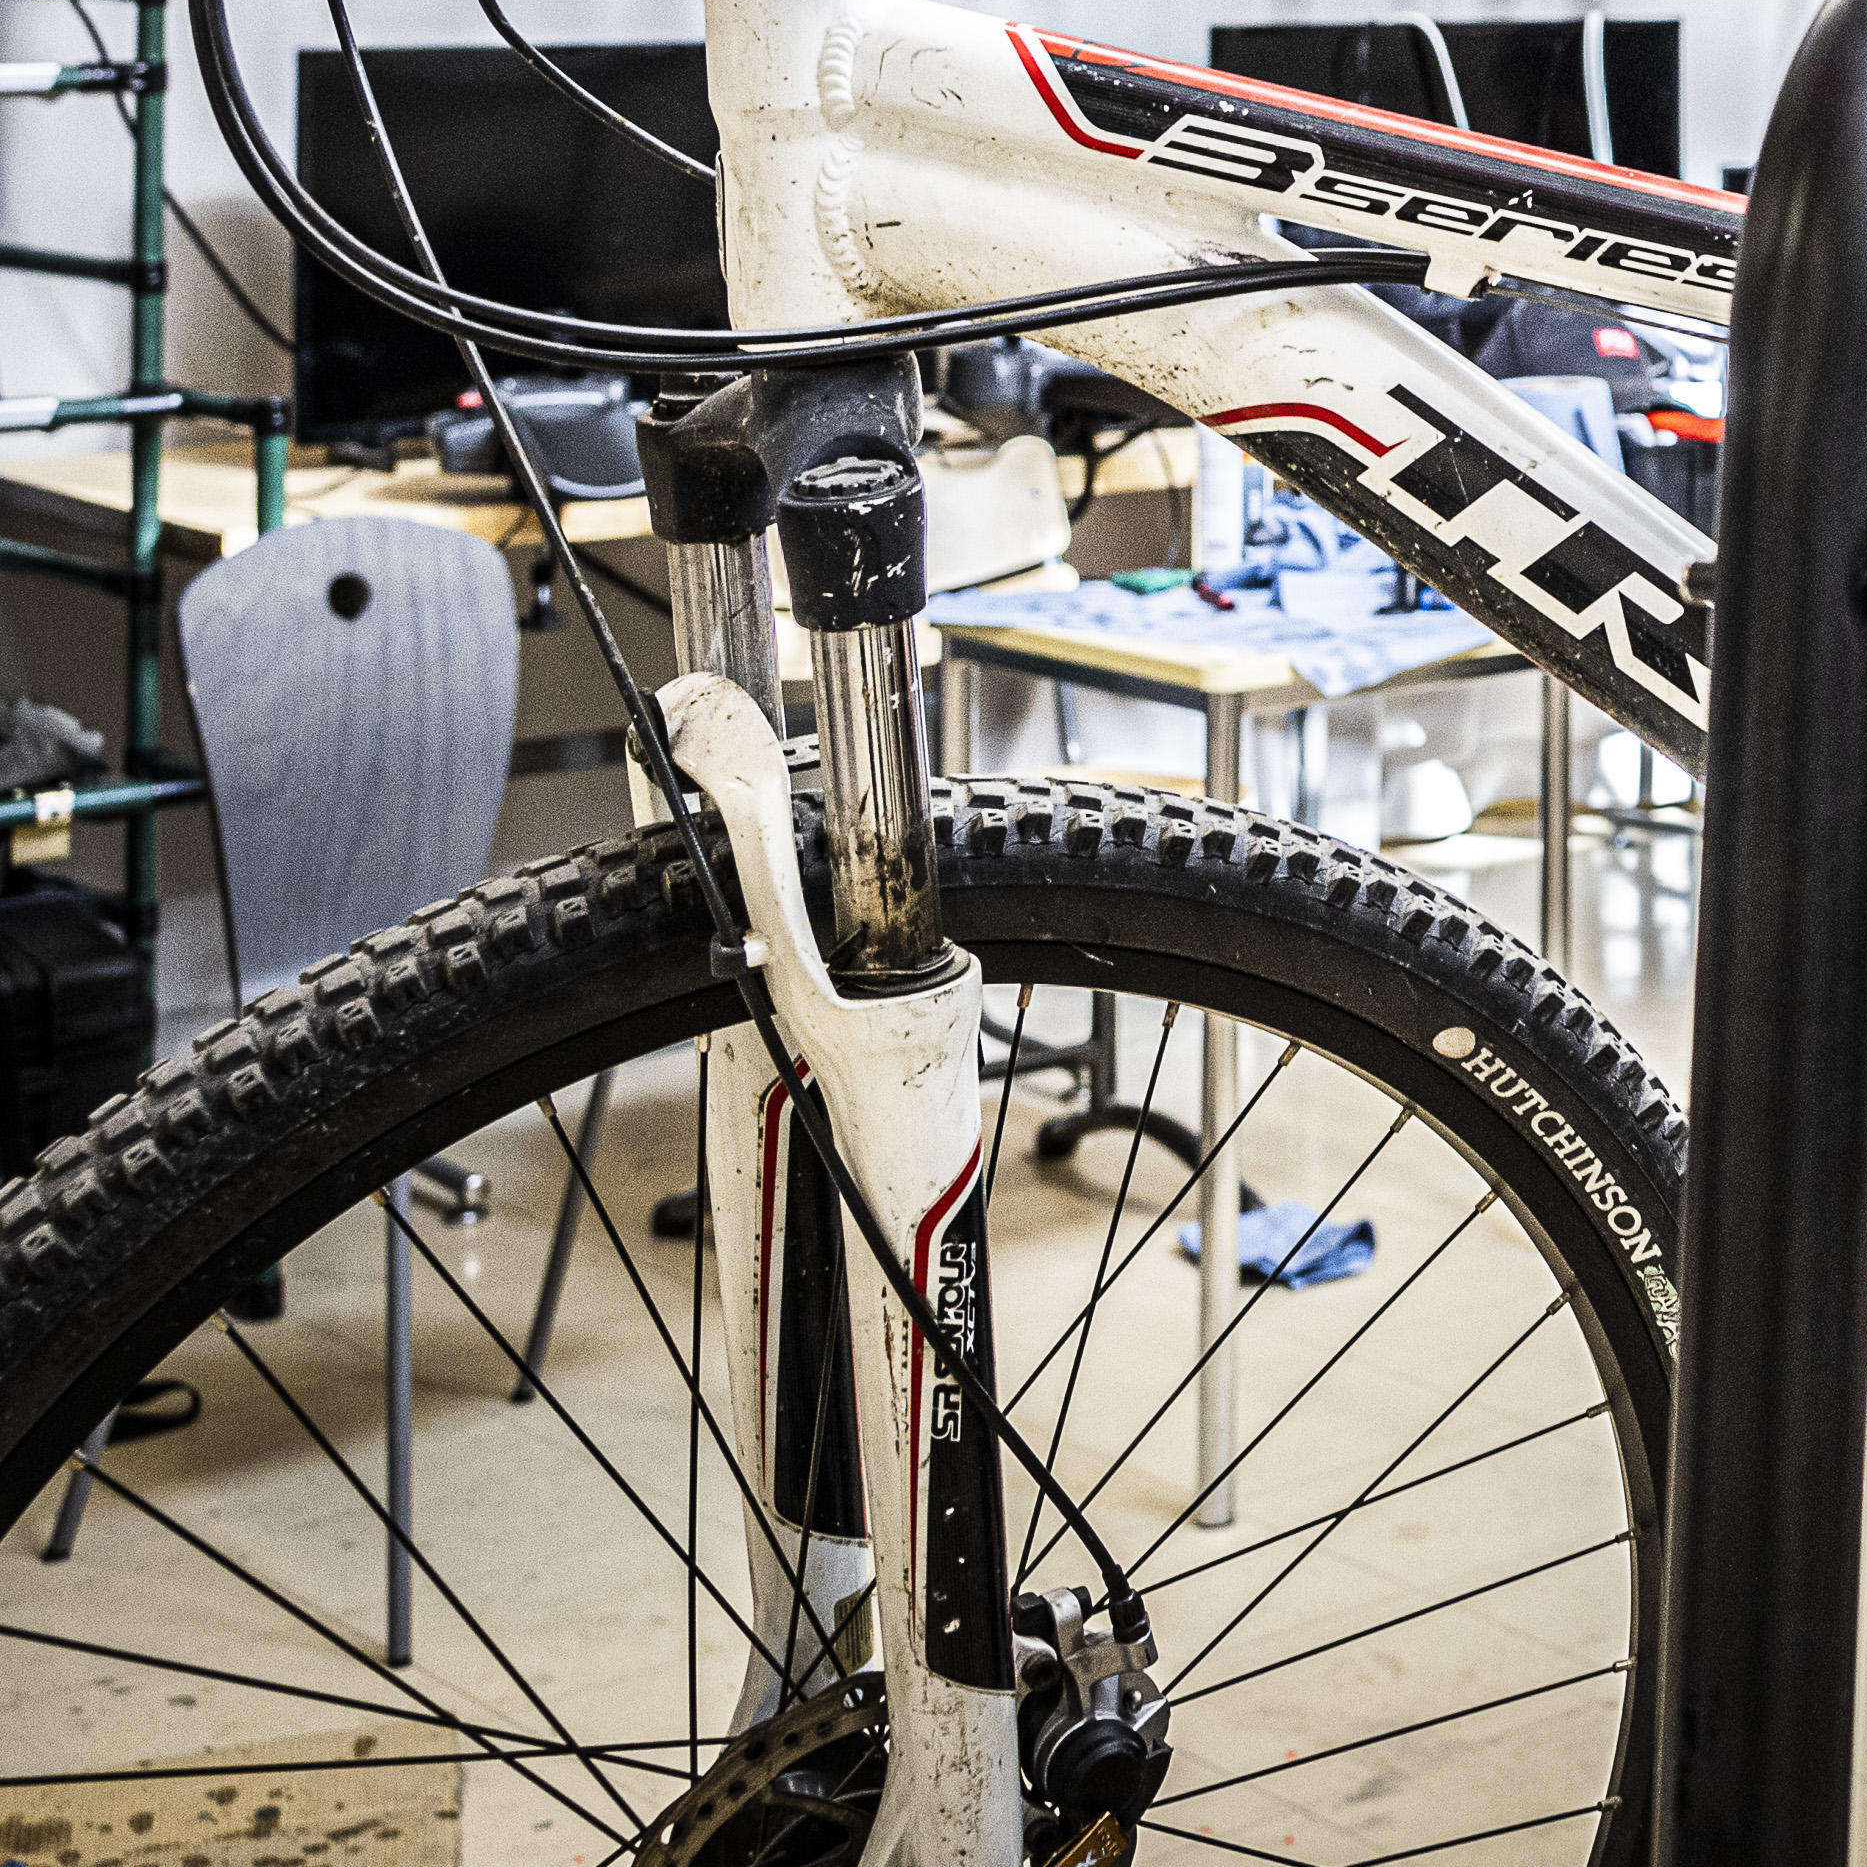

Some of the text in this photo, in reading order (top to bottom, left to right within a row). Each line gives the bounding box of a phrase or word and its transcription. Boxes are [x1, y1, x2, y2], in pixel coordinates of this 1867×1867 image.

[1461, 1047, 1662, 1264] HUTCHINSON
[929, 1241, 967, 1441] SR SNTOUR
